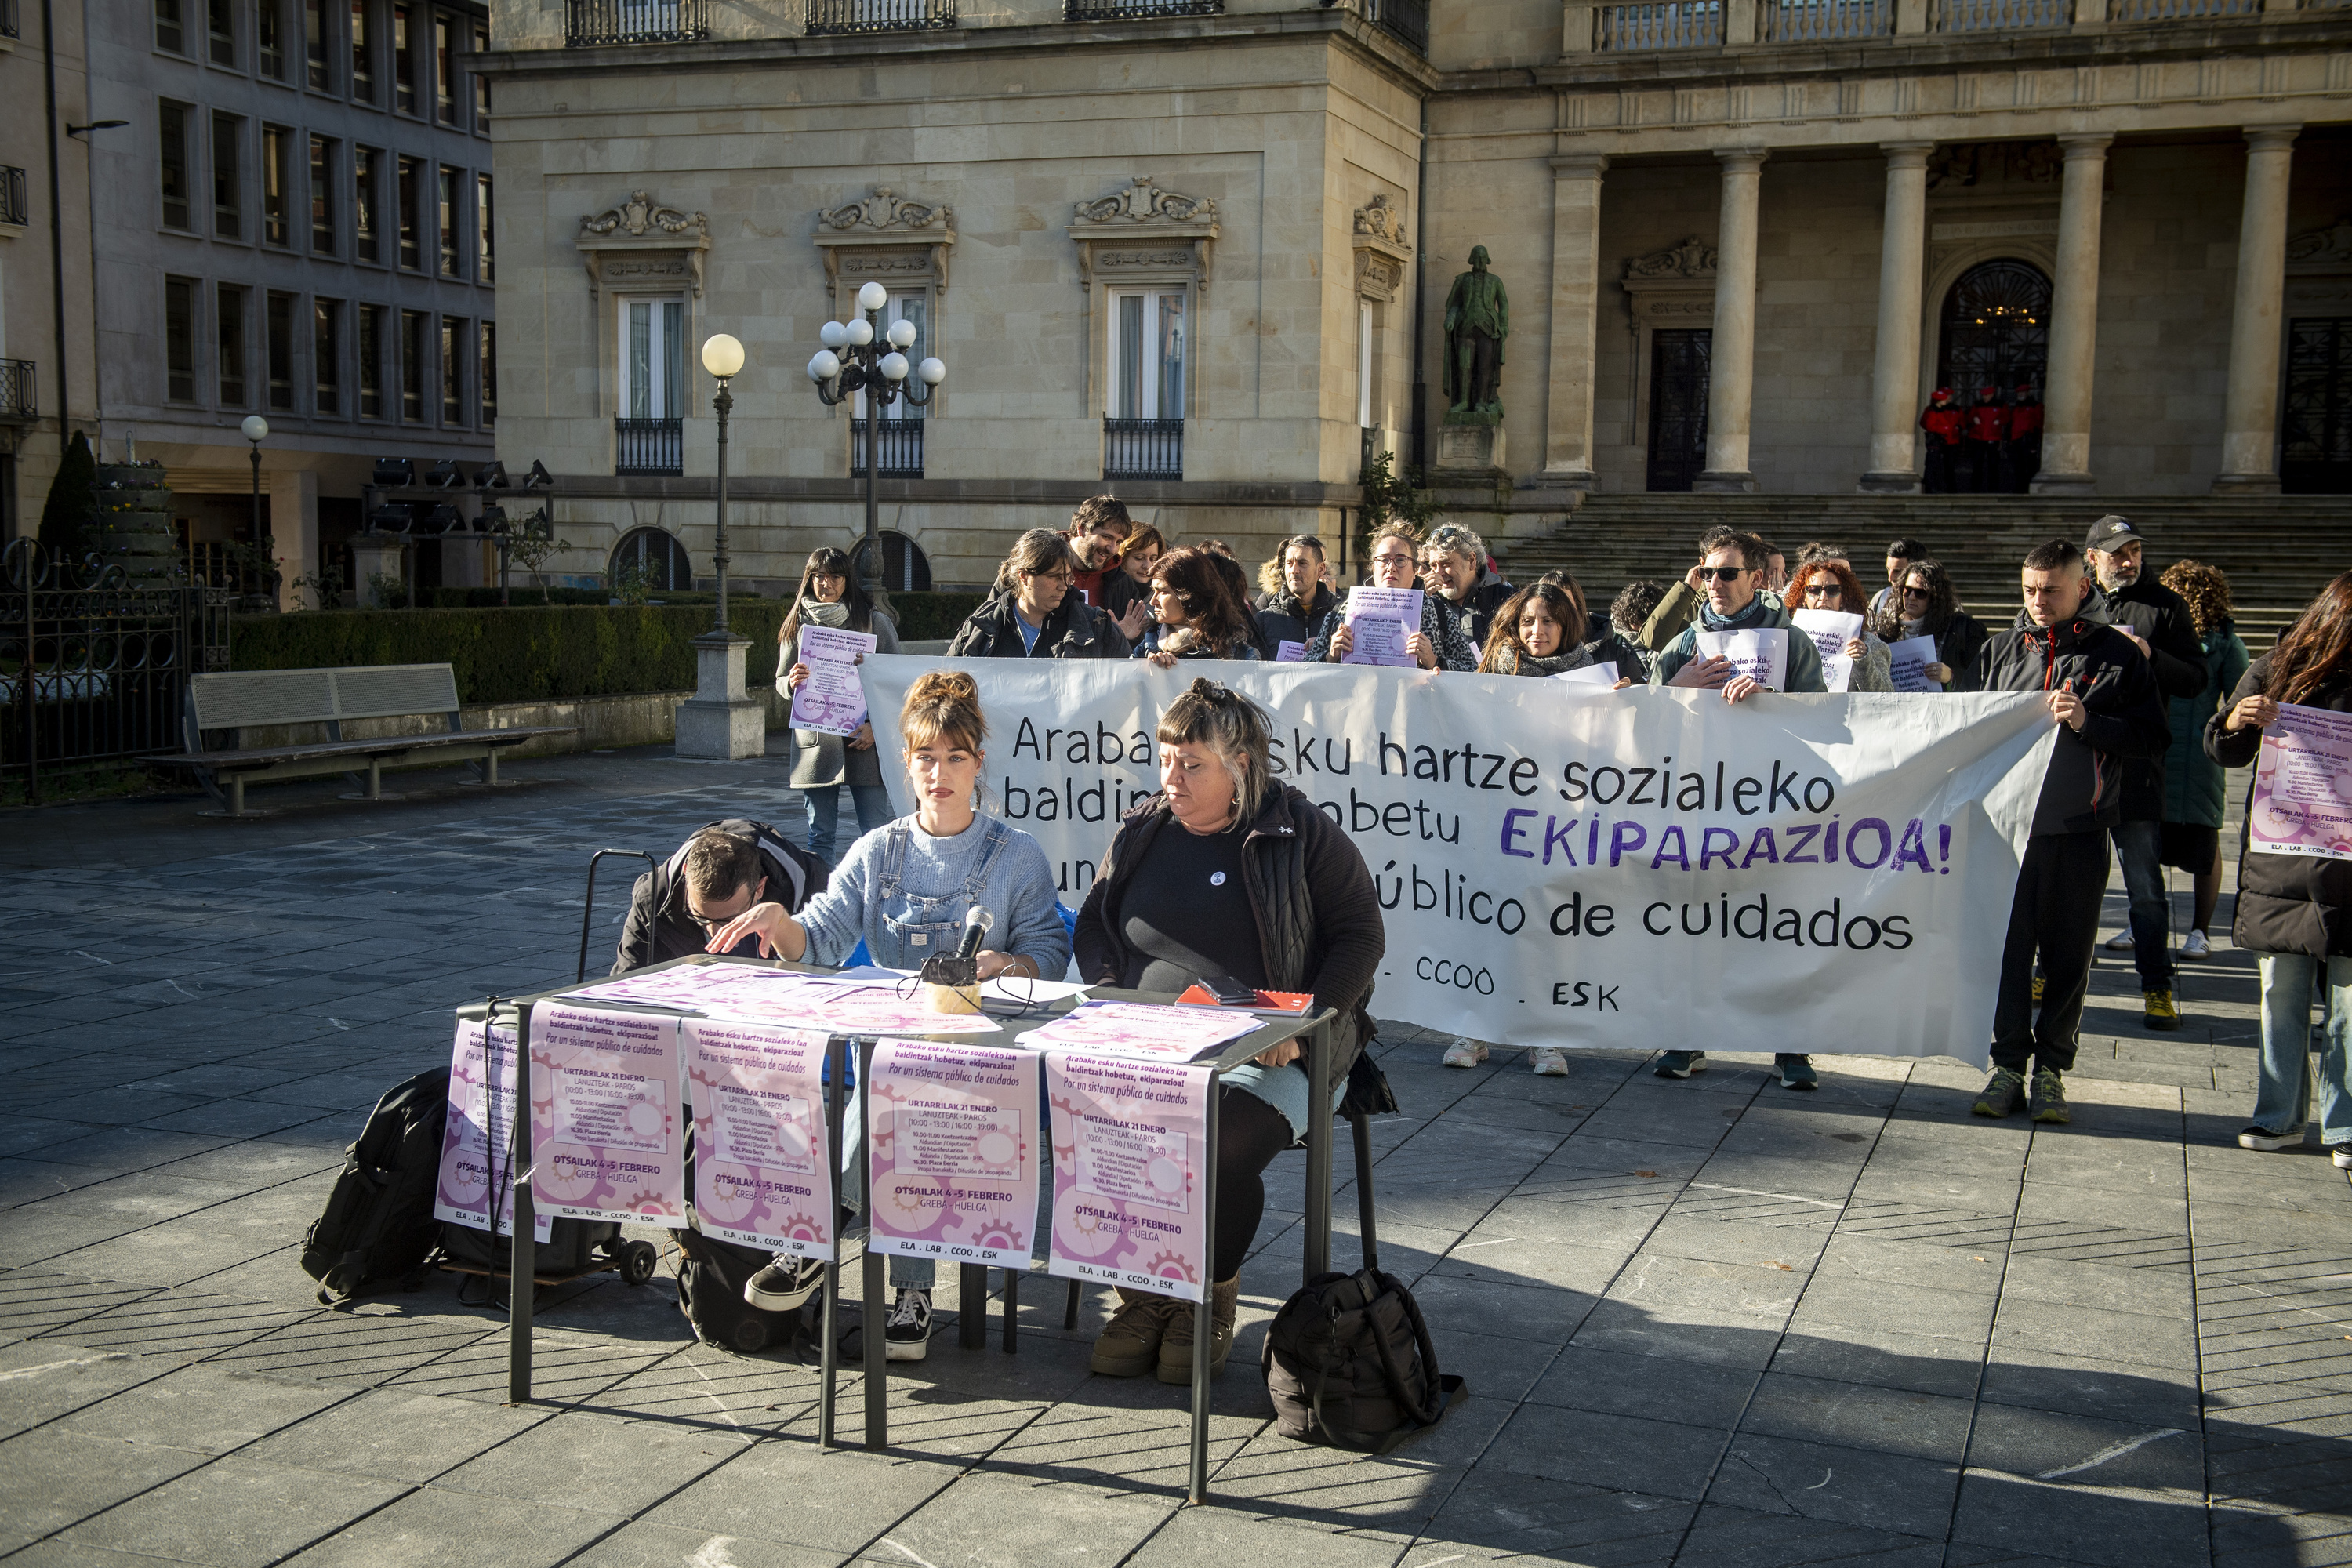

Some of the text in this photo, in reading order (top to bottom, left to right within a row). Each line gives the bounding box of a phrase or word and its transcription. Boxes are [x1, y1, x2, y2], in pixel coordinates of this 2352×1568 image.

[1739, 666, 1771, 675] sozialeko,
[2288, 747, 2324, 756] URTARRILAK
[1013, 716, 1835, 815] Araba sku hartze sozialeko
[2270, 808, 2303, 818] OTSAILAK
[1004, 775, 1951, 875] baldin obetu EKIPARAZIOA!
[1376, 860, 1526, 935] úblico
[1549, 891, 1615, 938] de
[1642, 892, 1914, 950] cuidados
[1417, 956, 1620, 1013] CCOO ESK
[550, 1011, 577, 1020] Arabako
[594, 1016, 615, 1025] hartze
[616, 1021, 647, 1030] sozialeko
[649, 1022, 659, 1031] lan
[550, 1021, 658, 1040] baldintzak hobetuz, ekiparazioa!
[546, 1033, 556, 1042] Por
[570, 1036, 594, 1048] sistema
[596, 1040, 620, 1051] público
[622, 1042, 631, 1051] de
[633, 1044, 663, 1056] cuidados
[700, 1038, 804, 1057] baldintzak hobetuz, ekiparazioa!
[895, 1051, 1015, 1070] baldintzak hobetuz, ekiparazioa!
[971, 1051, 1003, 1059] sozialeko
[888, 1062, 902, 1074] Por
[915, 1067, 943, 1079] sistema
[945, 1069, 972, 1082] público
[975, 1073, 983, 1083] de
[986, 1073, 1019, 1086] cuidados
[1066, 1055, 1096, 1064] Arabako
[1116, 1062, 1138, 1070] hartze
[1141, 1065, 1174, 1075] sozialeko
[1067, 1065, 1185, 1087] baldintzak hobetuz, ekiparazioa!
[1064, 1077, 1076, 1088] Por
[1088, 1082, 1115, 1094] sistema
[1116, 1086, 1142, 1098] público
[1145, 1088, 1153, 1100] de
[1156, 1091, 1188, 1105] cuidados
[909, 1100, 959, 1110] URTARRILAK
[919, 1111, 958, 1120] LANUZTEAK
[1084, 1114, 1130, 1129] URTARRILAK
[1140, 1124, 1166, 1134] ENERO
[909, 1119, 927, 1127] (10:00
[978, 1123, 997, 1132] 19:00)
[1094, 1127, 1156, 1143] LANUZTEAK PAROS
[554, 1156, 660, 1174] OTSAILAK FEBRERO
[576, 1170, 637, 1183] GREBA HUELGA
[716, 1174, 811, 1196] OTSAILAK FEBRERO
[895, 1186, 942, 1196] OTSAILAK
[968, 1191, 1012, 1201] FEBRERO
[920, 1200, 987, 1212] GREBA HUELGA
[1076, 1206, 1119, 1221] OTSAILAK
[1142, 1218, 1181, 1234] FEBRERO
[1098, 1222, 1160, 1242] GREBA HUELGA
[765, 1238, 783, 1247] CCOO
[793, 1242, 805, 1250] ESK
[925, 1244, 941, 1253] LAB
[951, 1247, 972, 1256] CCOO
[1079, 1265, 1174, 1290] ELA LAB CCOO ESK
